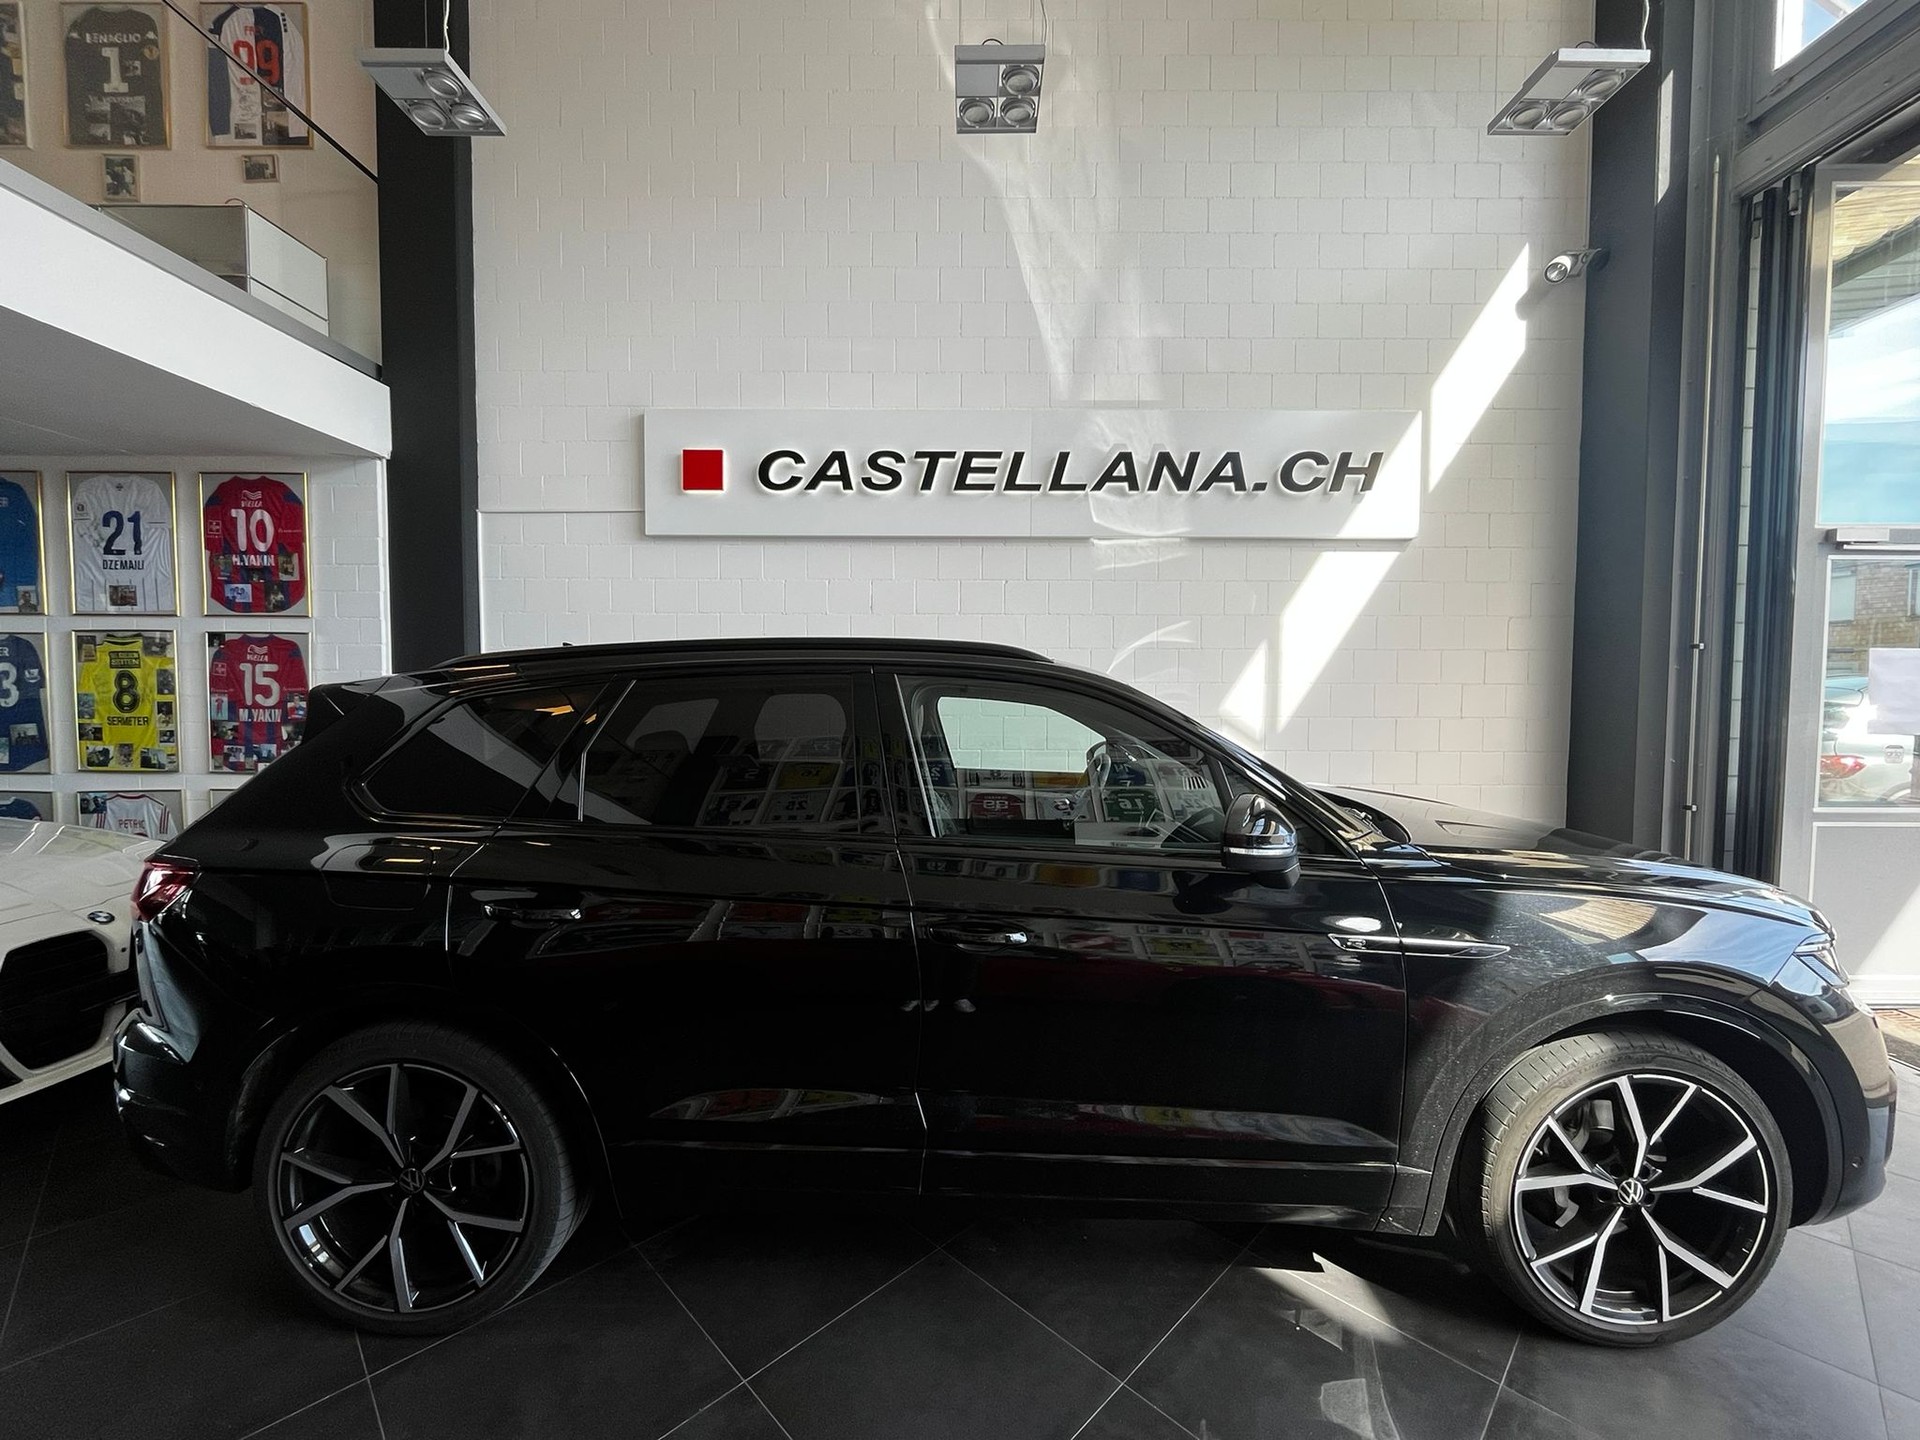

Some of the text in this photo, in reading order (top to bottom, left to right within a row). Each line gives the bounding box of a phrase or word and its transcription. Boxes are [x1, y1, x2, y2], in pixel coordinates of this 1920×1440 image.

[85, 32, 141, 44] BENAGLIO
[101, 46, 129, 93] 1
[757, 448, 1385, 493] CASTELLANA.CH
[102, 510, 143, 555] 21
[230, 508, 275, 552] 10
[232, 554, 276, 567] H.YAKIN
[113, 669, 140, 714] 8
[239, 662, 281, 707] 15
[107, 716, 149, 726] SERMETER
